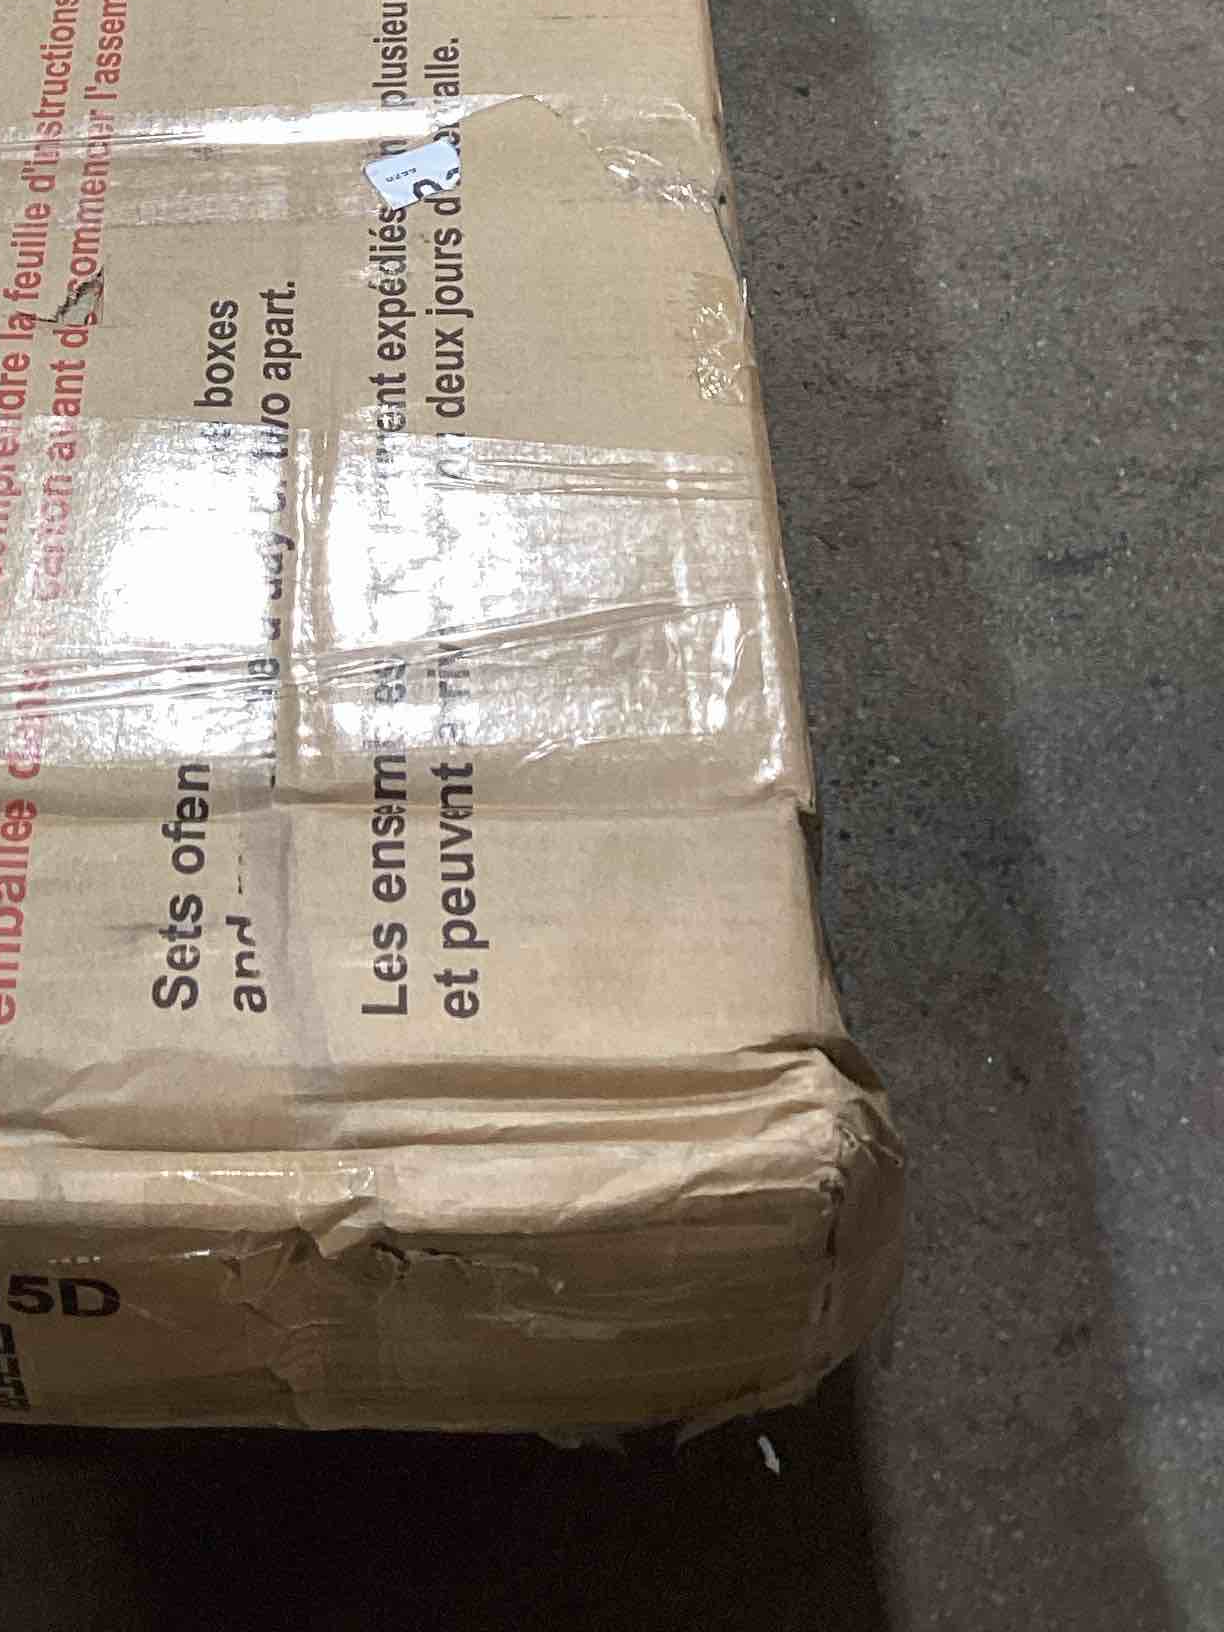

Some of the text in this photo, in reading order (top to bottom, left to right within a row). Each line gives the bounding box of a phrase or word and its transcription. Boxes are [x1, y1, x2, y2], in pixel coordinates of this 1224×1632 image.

[2, 202, 51, 302] feuille
[367, 205, 417, 361] expédiés
[424, 227, 474, 319] jours
[193, 299, 240, 409] boxes
[259, 279, 303, 383] apart.
[425, 325, 466, 419] deux
[151, 763, 211, 1011] Sets ofen
[429, 761, 490, 949] peuvent
[361, 922, 409, 1016] Les
[432, 967, 481, 1020] et
